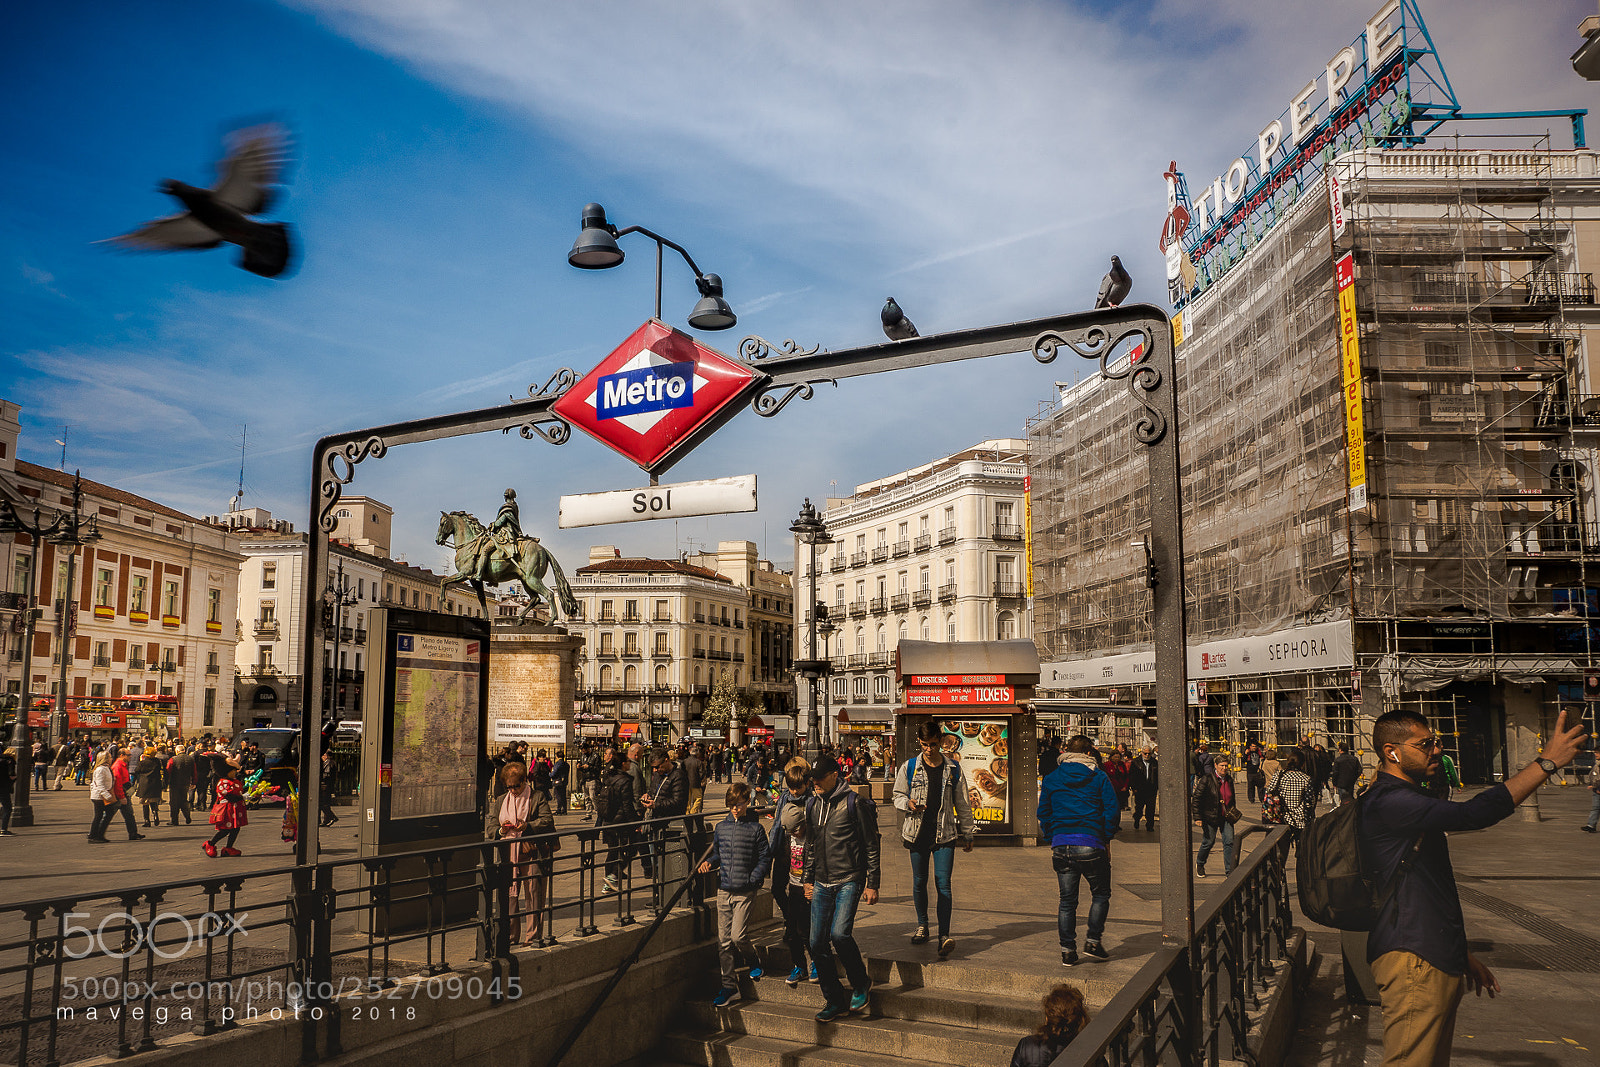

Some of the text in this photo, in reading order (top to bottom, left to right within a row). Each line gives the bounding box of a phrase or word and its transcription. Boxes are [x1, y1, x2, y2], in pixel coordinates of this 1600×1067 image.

[1193, 0, 1403, 235] TIO PEPE
[1194, 238, 1214, 261] SOL
[1215, 221, 1229, 243] DE
[1231, 165, 1293, 229] ANDALUCIA
[1296, 63, 1403, 170] EMBOTELLADO
[1331, 176, 1343, 230] ATES
[1342, 295, 1358, 422] Lartec
[603, 374, 686, 409] Metro
[632, 489, 672, 514] Sol
[1209, 652, 1226, 663] Lartec
[1268, 638, 1328, 660] SEPHORA
[938, 676, 948, 684] BUS
[974, 686, 1010, 702] TICKETS
